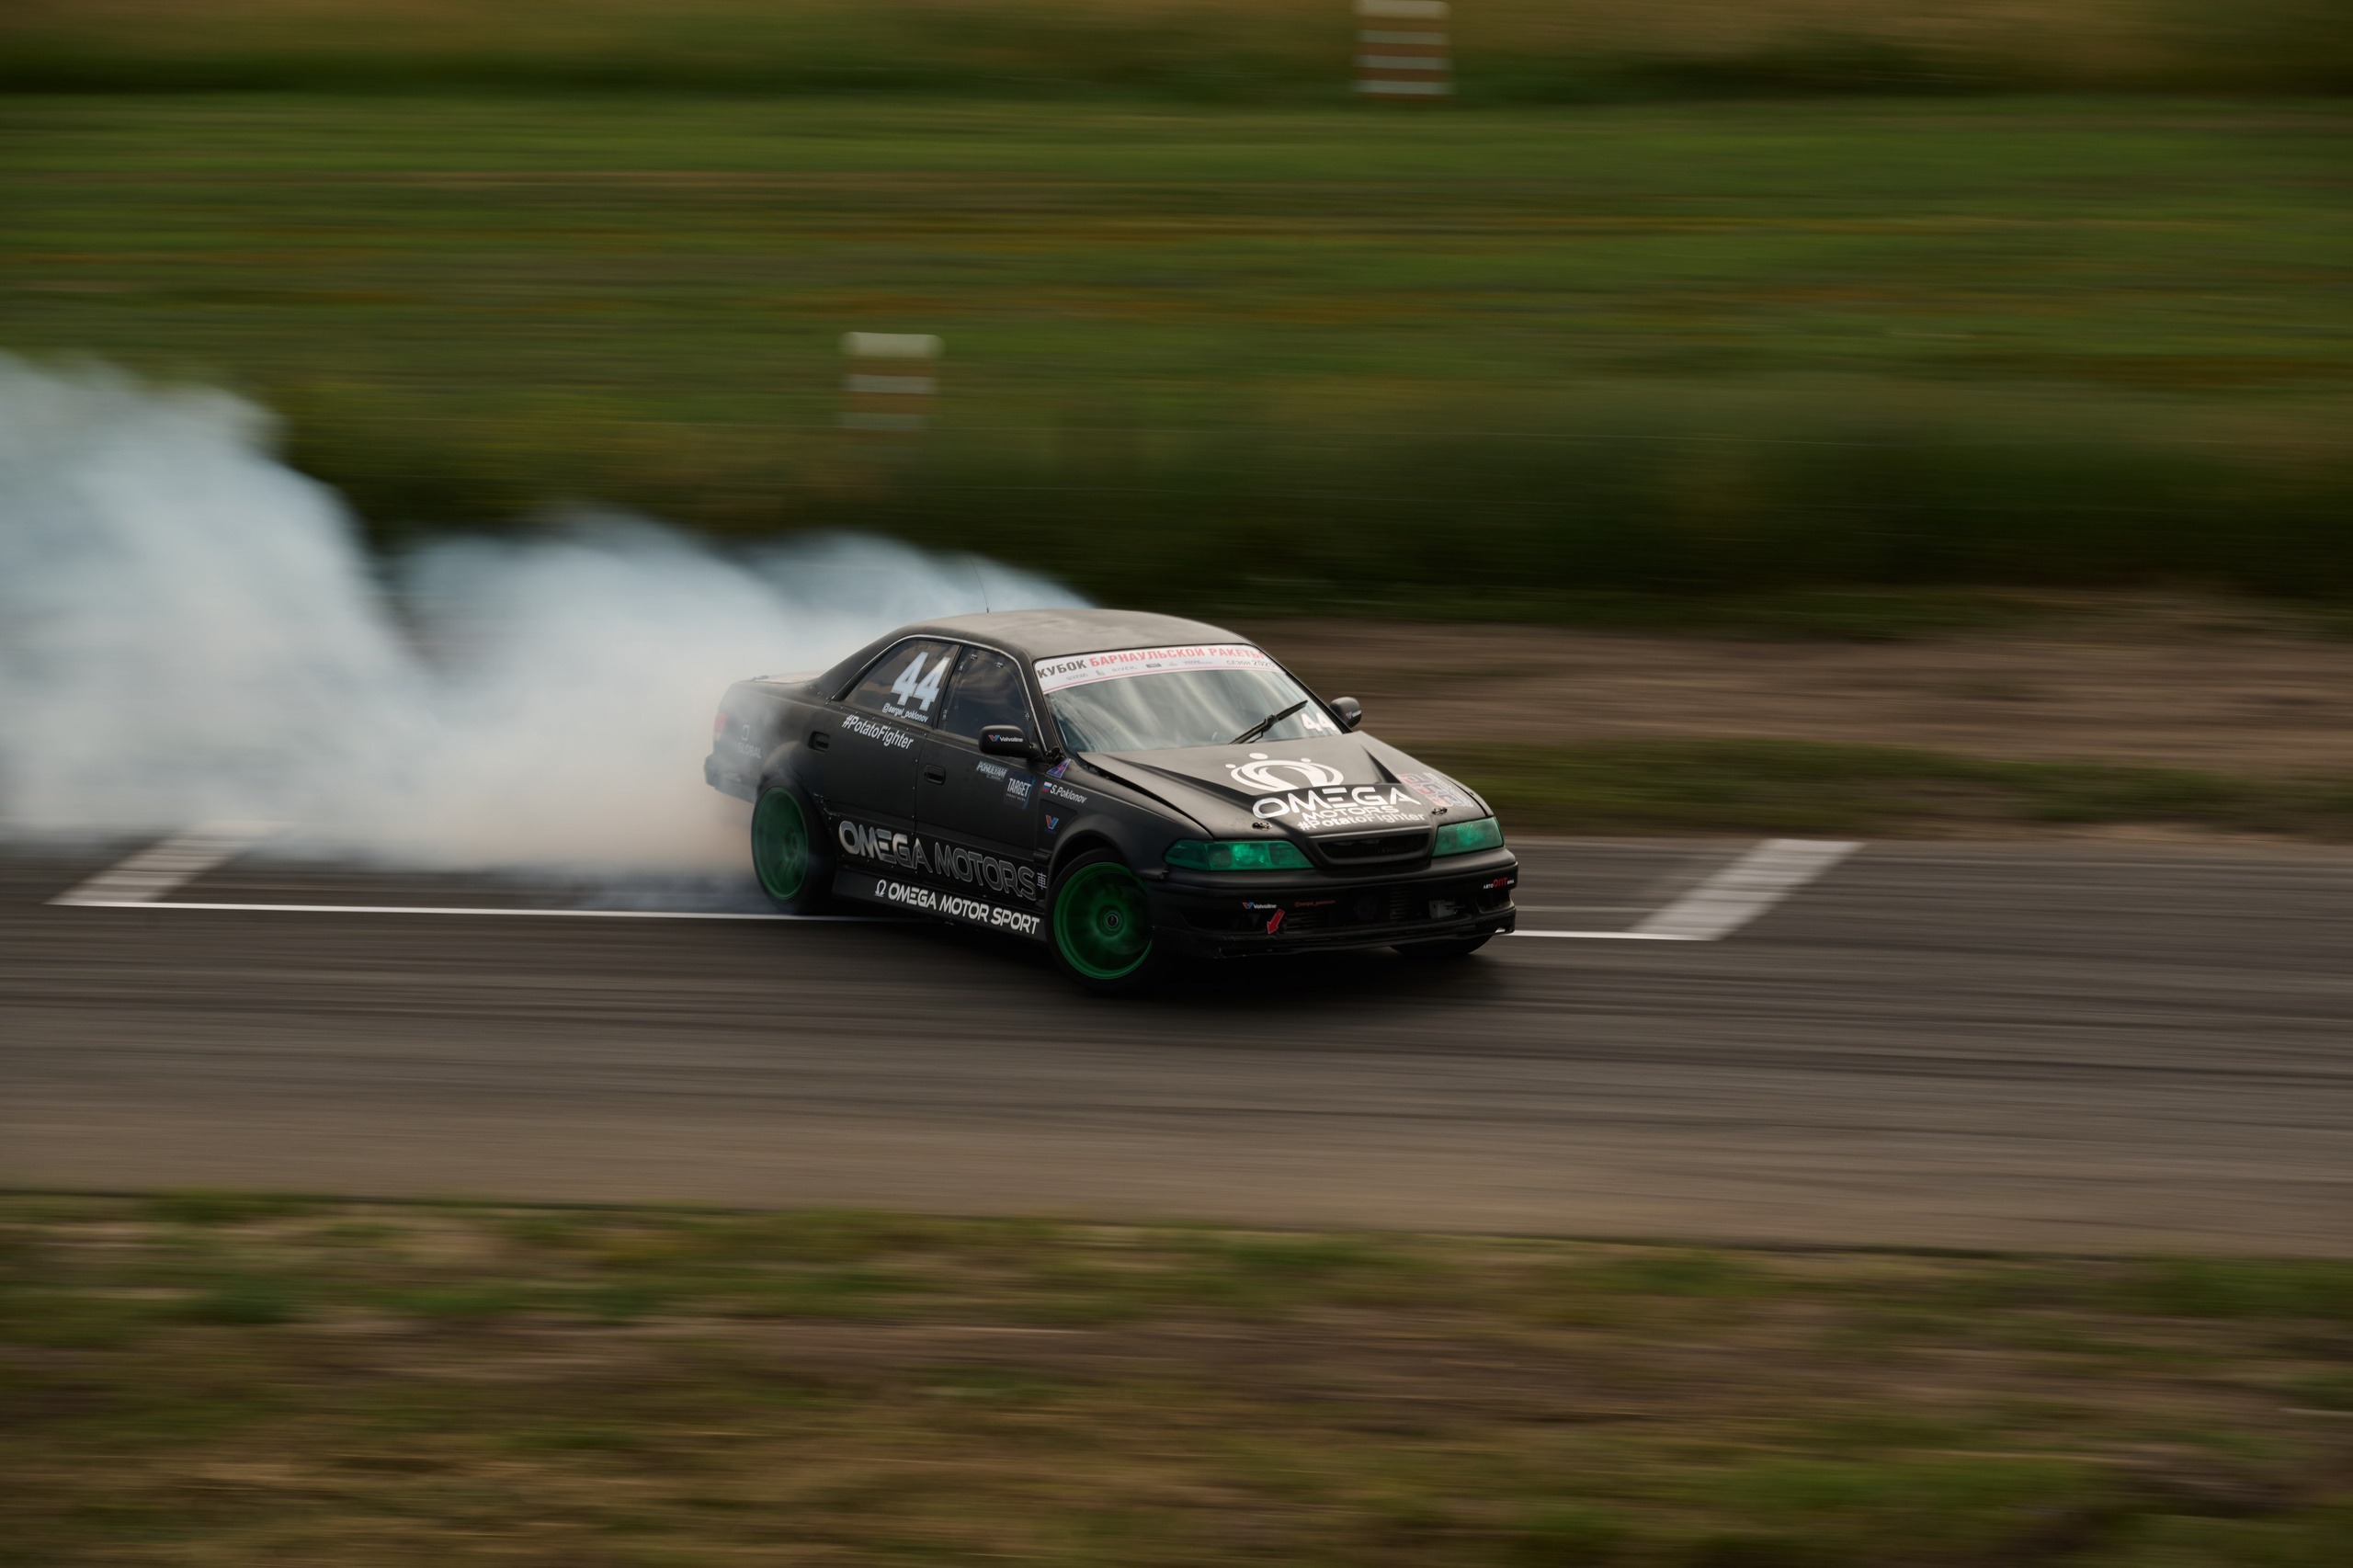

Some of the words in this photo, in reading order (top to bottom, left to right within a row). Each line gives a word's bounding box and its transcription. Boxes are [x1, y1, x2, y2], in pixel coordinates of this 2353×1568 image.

[1037, 660, 1086, 678] КУБОК
[1089, 645, 1206, 667] БАРНАУЛЬСКОЙ
[1209, 647, 1265, 659] РАКЕТЫ
[891, 651, 950, 711] 44
[842, 714, 915, 749] #PotatoFighter
[1301, 712, 1336, 732] 44
[1006, 778, 1031, 798] TARGET
[1050, 784, 1087, 803] S.Poklonov
[1252, 786, 1422, 820] OMEGA
[1297, 812, 1426, 832] #PotatoFighter
[1302, 805, 1399, 822] MOTORS
[838, 820, 933, 873] OMEGA
[934, 841, 1037, 901] MOTORS
[888, 882, 937, 910] OMEGA
[938, 893, 989, 923] MOTOR
[991, 906, 1040, 935] SPORT
